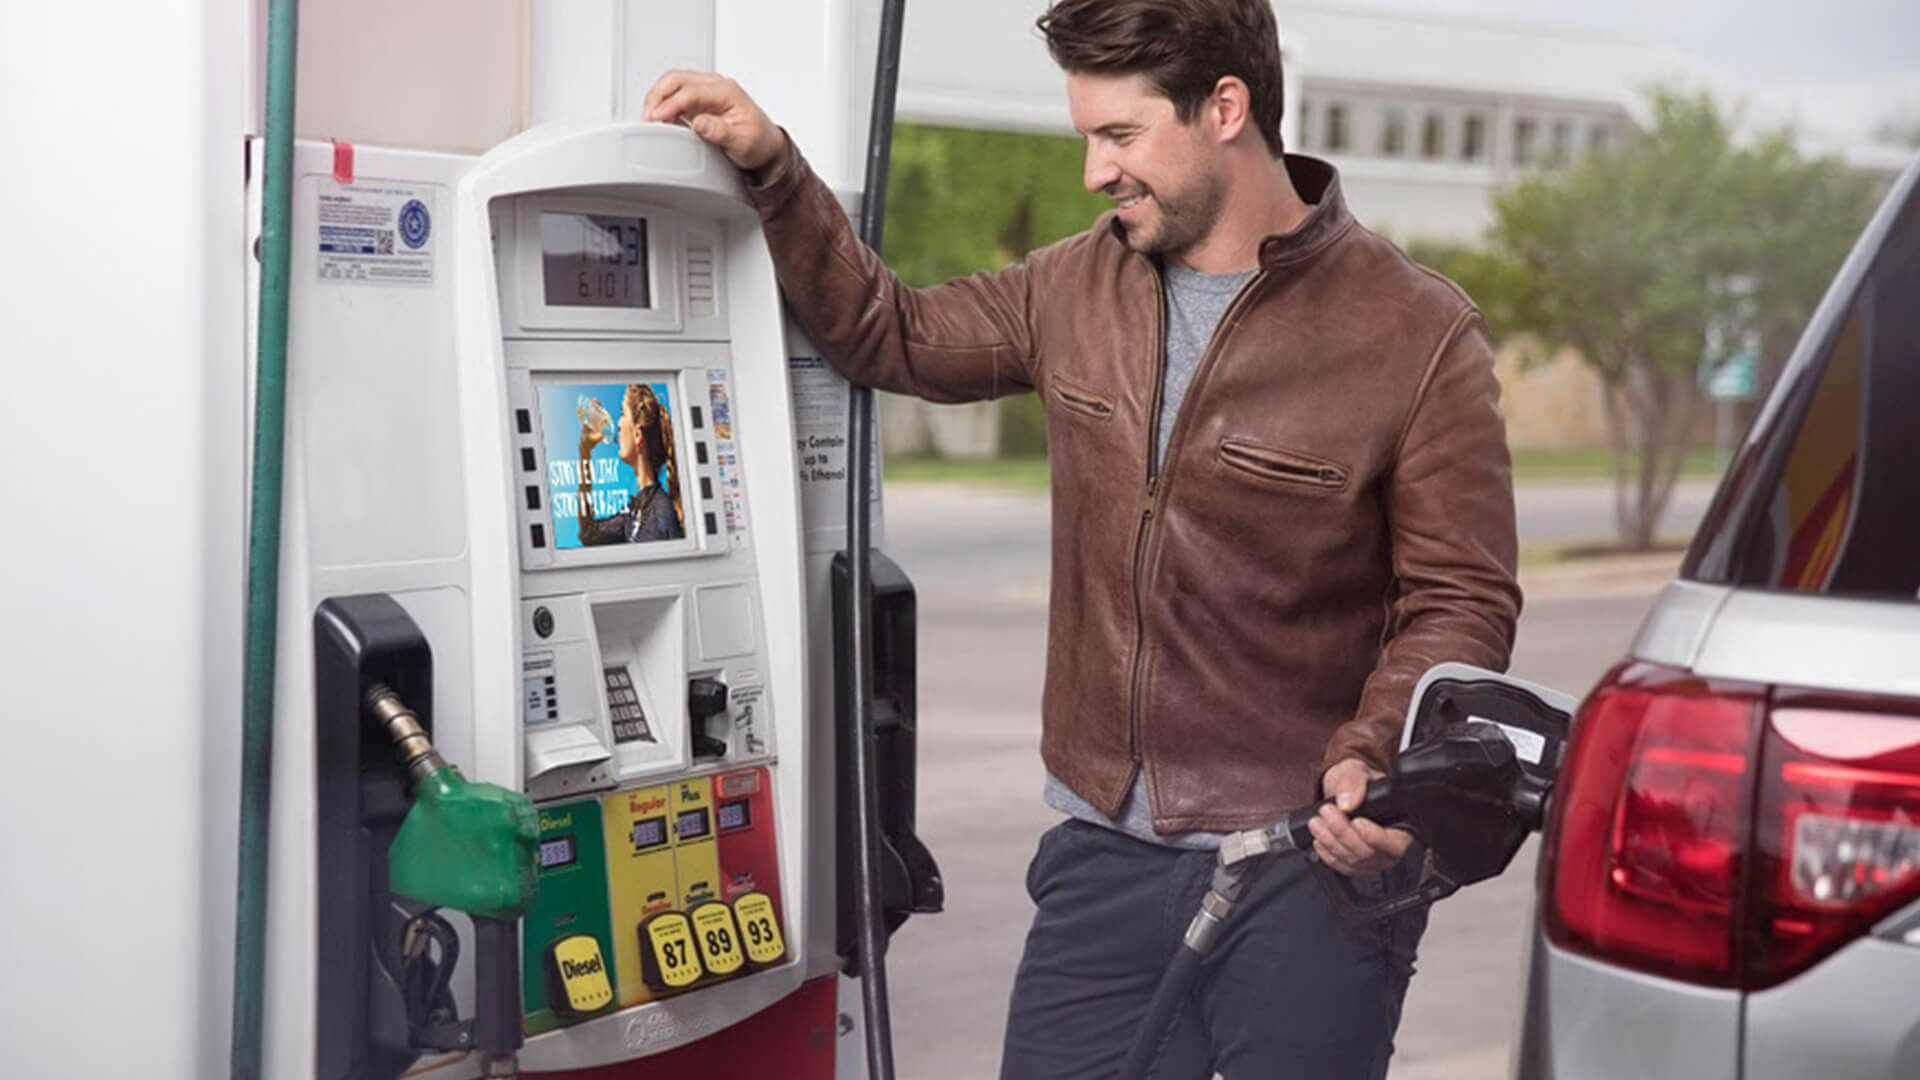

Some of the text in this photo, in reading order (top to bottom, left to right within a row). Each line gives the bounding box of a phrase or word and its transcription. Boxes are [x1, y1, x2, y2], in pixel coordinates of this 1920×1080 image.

[809, 434, 845, 449] Contain
[804, 452, 828, 467] up to
[811, 466, 845, 483] Ethanol
[629, 795, 666, 814] Regular
[705, 926, 732, 957] 89
[747, 917, 774, 946] 93
[662, 937, 687, 969] 87
[562, 952, 603, 980] Diesel
